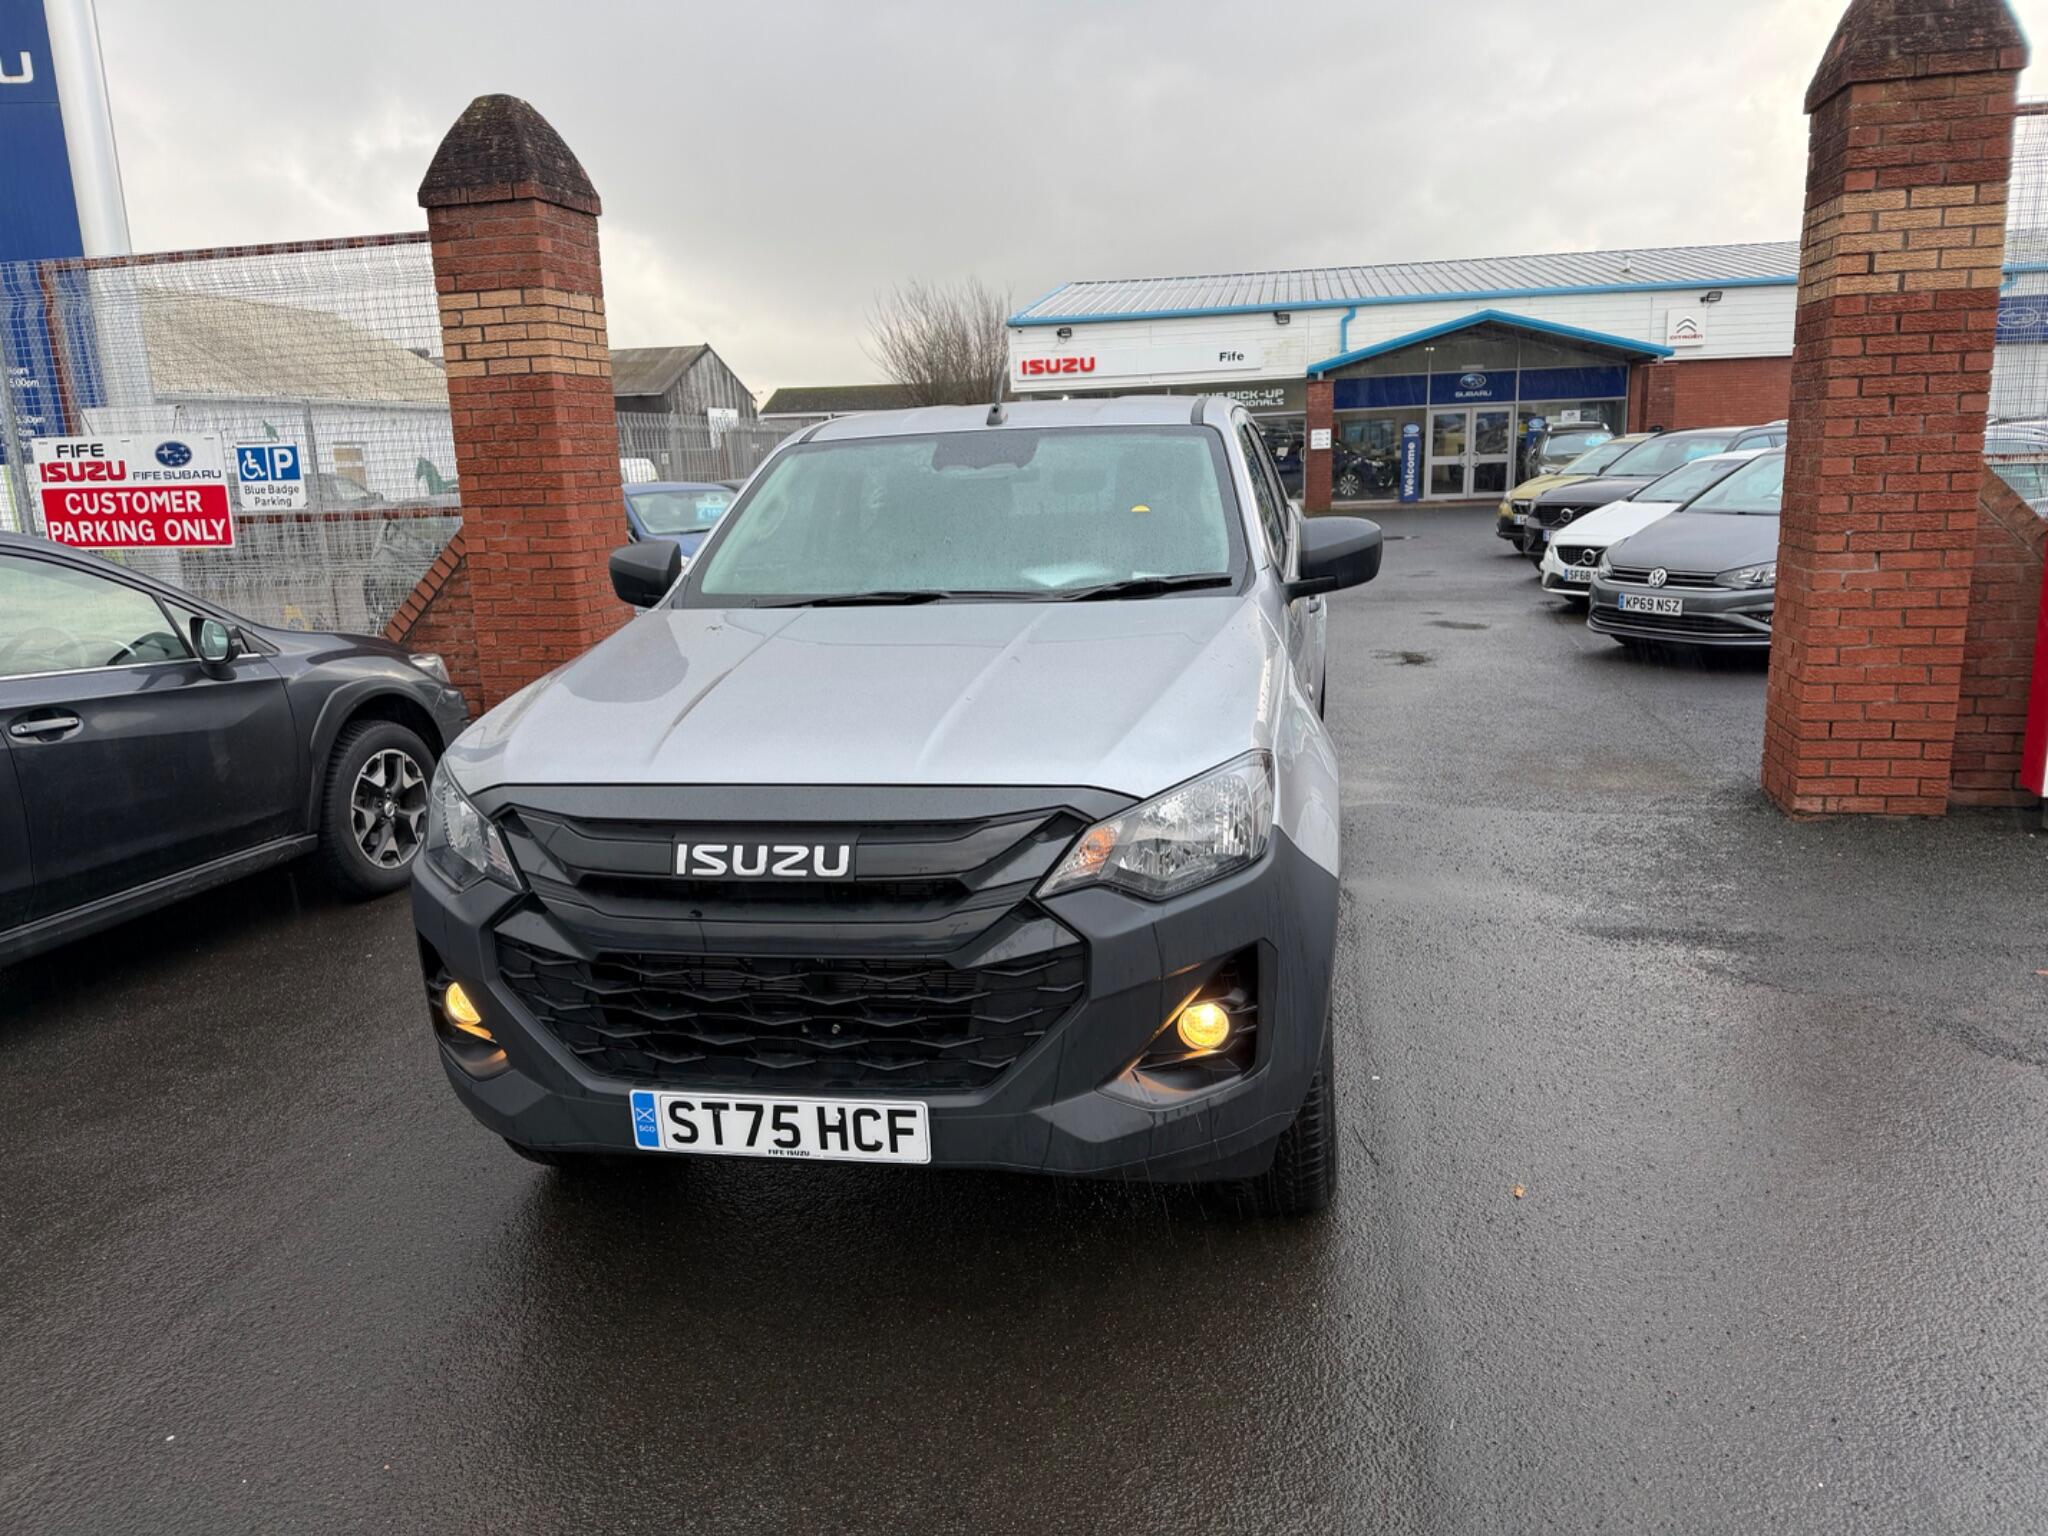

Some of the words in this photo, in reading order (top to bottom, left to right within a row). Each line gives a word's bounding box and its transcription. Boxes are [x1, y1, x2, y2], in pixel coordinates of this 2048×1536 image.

[1219, 351, 1245, 362] Fife
[1022, 357, 1095, 375] ISUZU
[1227, 388, 1284, 401] PICK-UP
[1455, 390, 1492, 398] SUBARU
[56, 444, 104, 458] FIFE
[39, 460, 126, 483] ISUZU
[273, 448, 293, 478] P
[1404, 442, 1416, 496] Welcome
[132, 471, 162, 481] FIFE
[164, 469, 222, 480] SUBARU
[244, 485, 266, 495] Blue
[267, 484, 299, 496] Badge
[65, 490, 203, 515] CUSTOMER
[254, 496, 292, 507] Parking
[49, 519, 156, 543] PARKING
[164, 518, 226, 541] ONLY
[1626, 596, 1655, 611] KP69
[1656, 599, 1680, 613] NSZ
[676, 843, 850, 877] ISUZU
[668, 1101, 801, 1149] ST75
[816, 1106, 917, 1153] HCF
